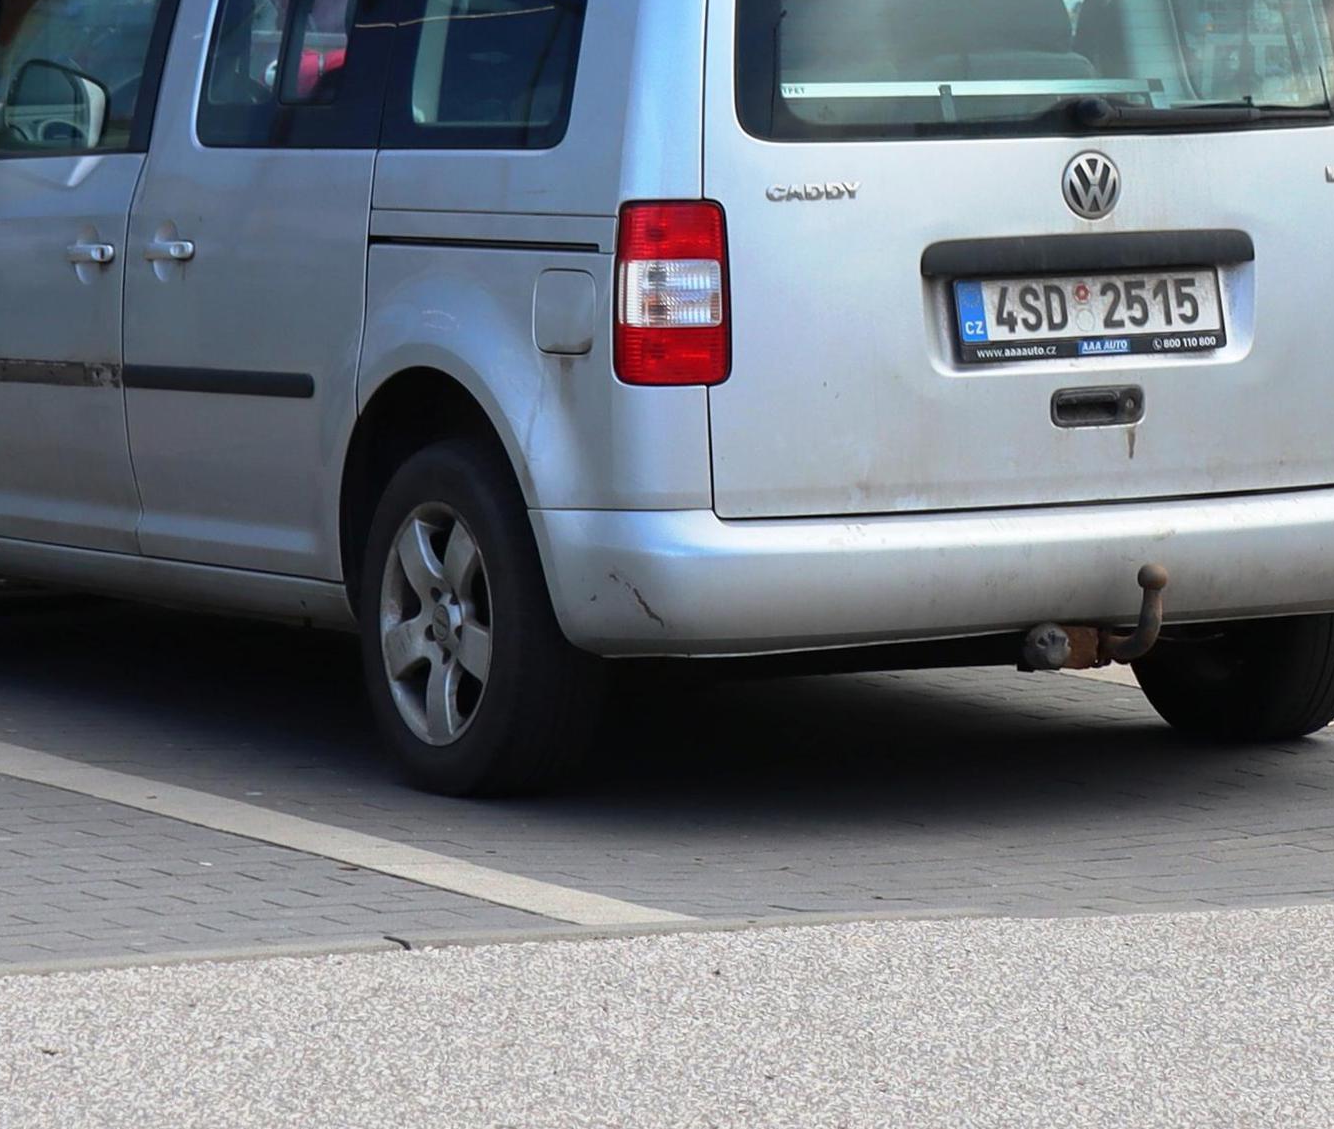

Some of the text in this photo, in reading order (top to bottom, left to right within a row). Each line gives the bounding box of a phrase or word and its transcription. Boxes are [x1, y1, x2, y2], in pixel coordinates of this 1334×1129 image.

[765, 181, 861, 202] CADDY
[995, 277, 1199, 334] 4SD 2515
[965, 321, 985, 336] CZ
[976, 335, 1217, 359] www.aaaauto.cz AAA AUTO 800 110 800
